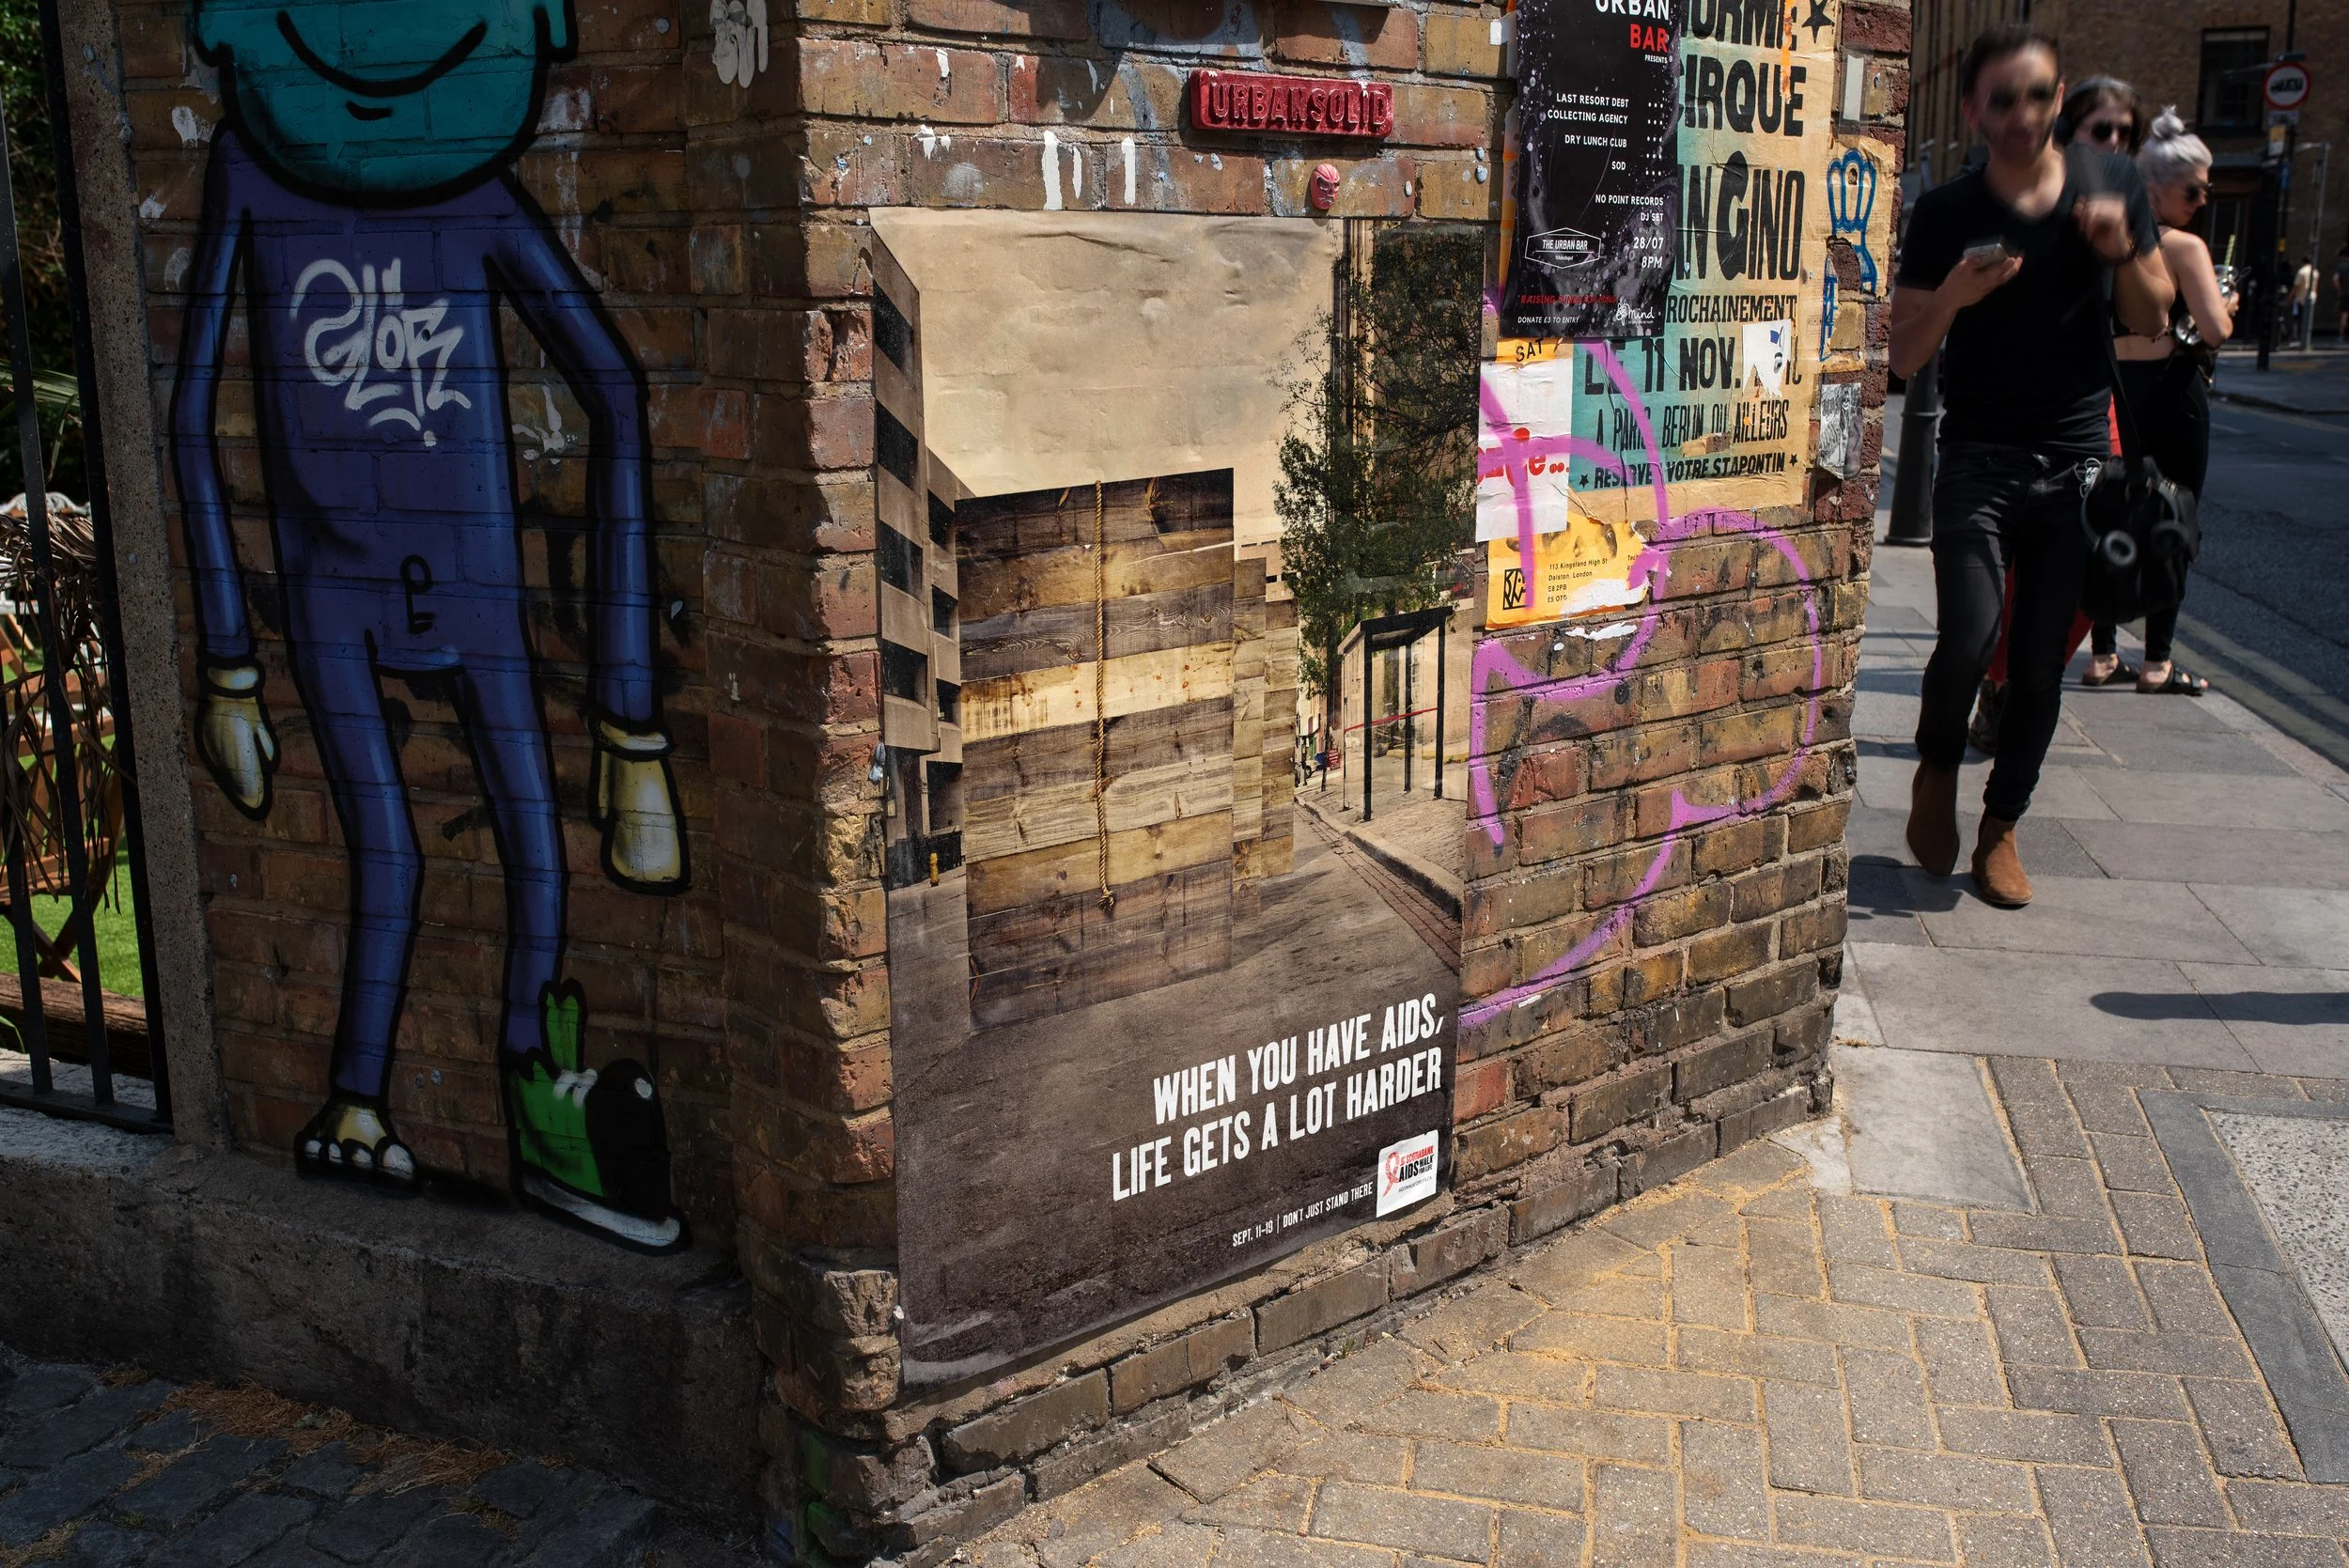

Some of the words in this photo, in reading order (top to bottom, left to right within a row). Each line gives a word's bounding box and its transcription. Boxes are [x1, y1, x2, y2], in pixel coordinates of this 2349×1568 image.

[1630, 23, 1668, 53] BAR
[1644, 54, 1668, 64] PRESENTS
[1556, 93, 1577, 103] LAST
[1579, 95, 1610, 105] RESORT
[1611, 98, 1629, 108] DEBT
[1679, 54, 1807, 137] IRQUE
[1547, 109, 1596, 122] COLLECTING
[1599, 114, 1628, 124] AGENCY
[1564, 134, 1581, 144] DRY
[1583, 135, 1608, 147] LUNCH
[1610, 138, 1627, 147] CLUB
[1611, 161, 1626, 170] SOD
[1595, 194, 1607, 203] NO
[1608, 194, 1629, 205] POINT
[1630, 195, 1664, 206] RECORDS
[1641, 212, 1650, 222] DJ
[1651, 212, 1664, 222] SET
[1543, 239, 1554, 249] THE
[1555, 240, 1576, 250] URBAN
[1576, 240, 1588, 250] BAR
[1633, 236, 1664, 250] 28/07
[1641, 256, 1663, 269] 8PM
[1520, 294, 1556, 304] RAISING
[1666, 294, 1797, 324] ROCHAINEMENT
[1516, 338, 1544, 362] SAT
[1641, 337, 1665, 393] 11
[1679, 336, 1741, 391] NOV.
[1733, 398, 1790, 444] AILLEURS
[1666, 458, 1710, 483] VOTRE
[1560, 560, 1587, 570] Kingsland
[1588, 559, 1601, 567] High
[1572, 570, 1593, 579] London
[1153, 1054, 1237, 1126] WHEN
[1247, 1035, 1298, 1095] YOU
[1307, 1013, 1372, 1077] HAVE
[1380, 992, 1444, 1053] AIDS,
[1112, 1135, 1172, 1202] LIFE
[1183, 1110, 1251, 1177] GETS
[1261, 1101, 1279, 1151] A
[1289, 1081, 1337, 1141] LOT
[1346, 1047, 1442, 1121] HARDER
[1398, 1161, 1419, 1182] AIDS
[1419, 1155, 1434, 1167] WALK
[1232, 1226, 1253, 1248] SEPT.
[1283, 1208, 1303, 1228] DON'T
[1305, 1201, 1324, 1219] JUST
[1325, 1191, 1349, 1212] STAND
[1351, 1181, 1374, 1202] THERE
